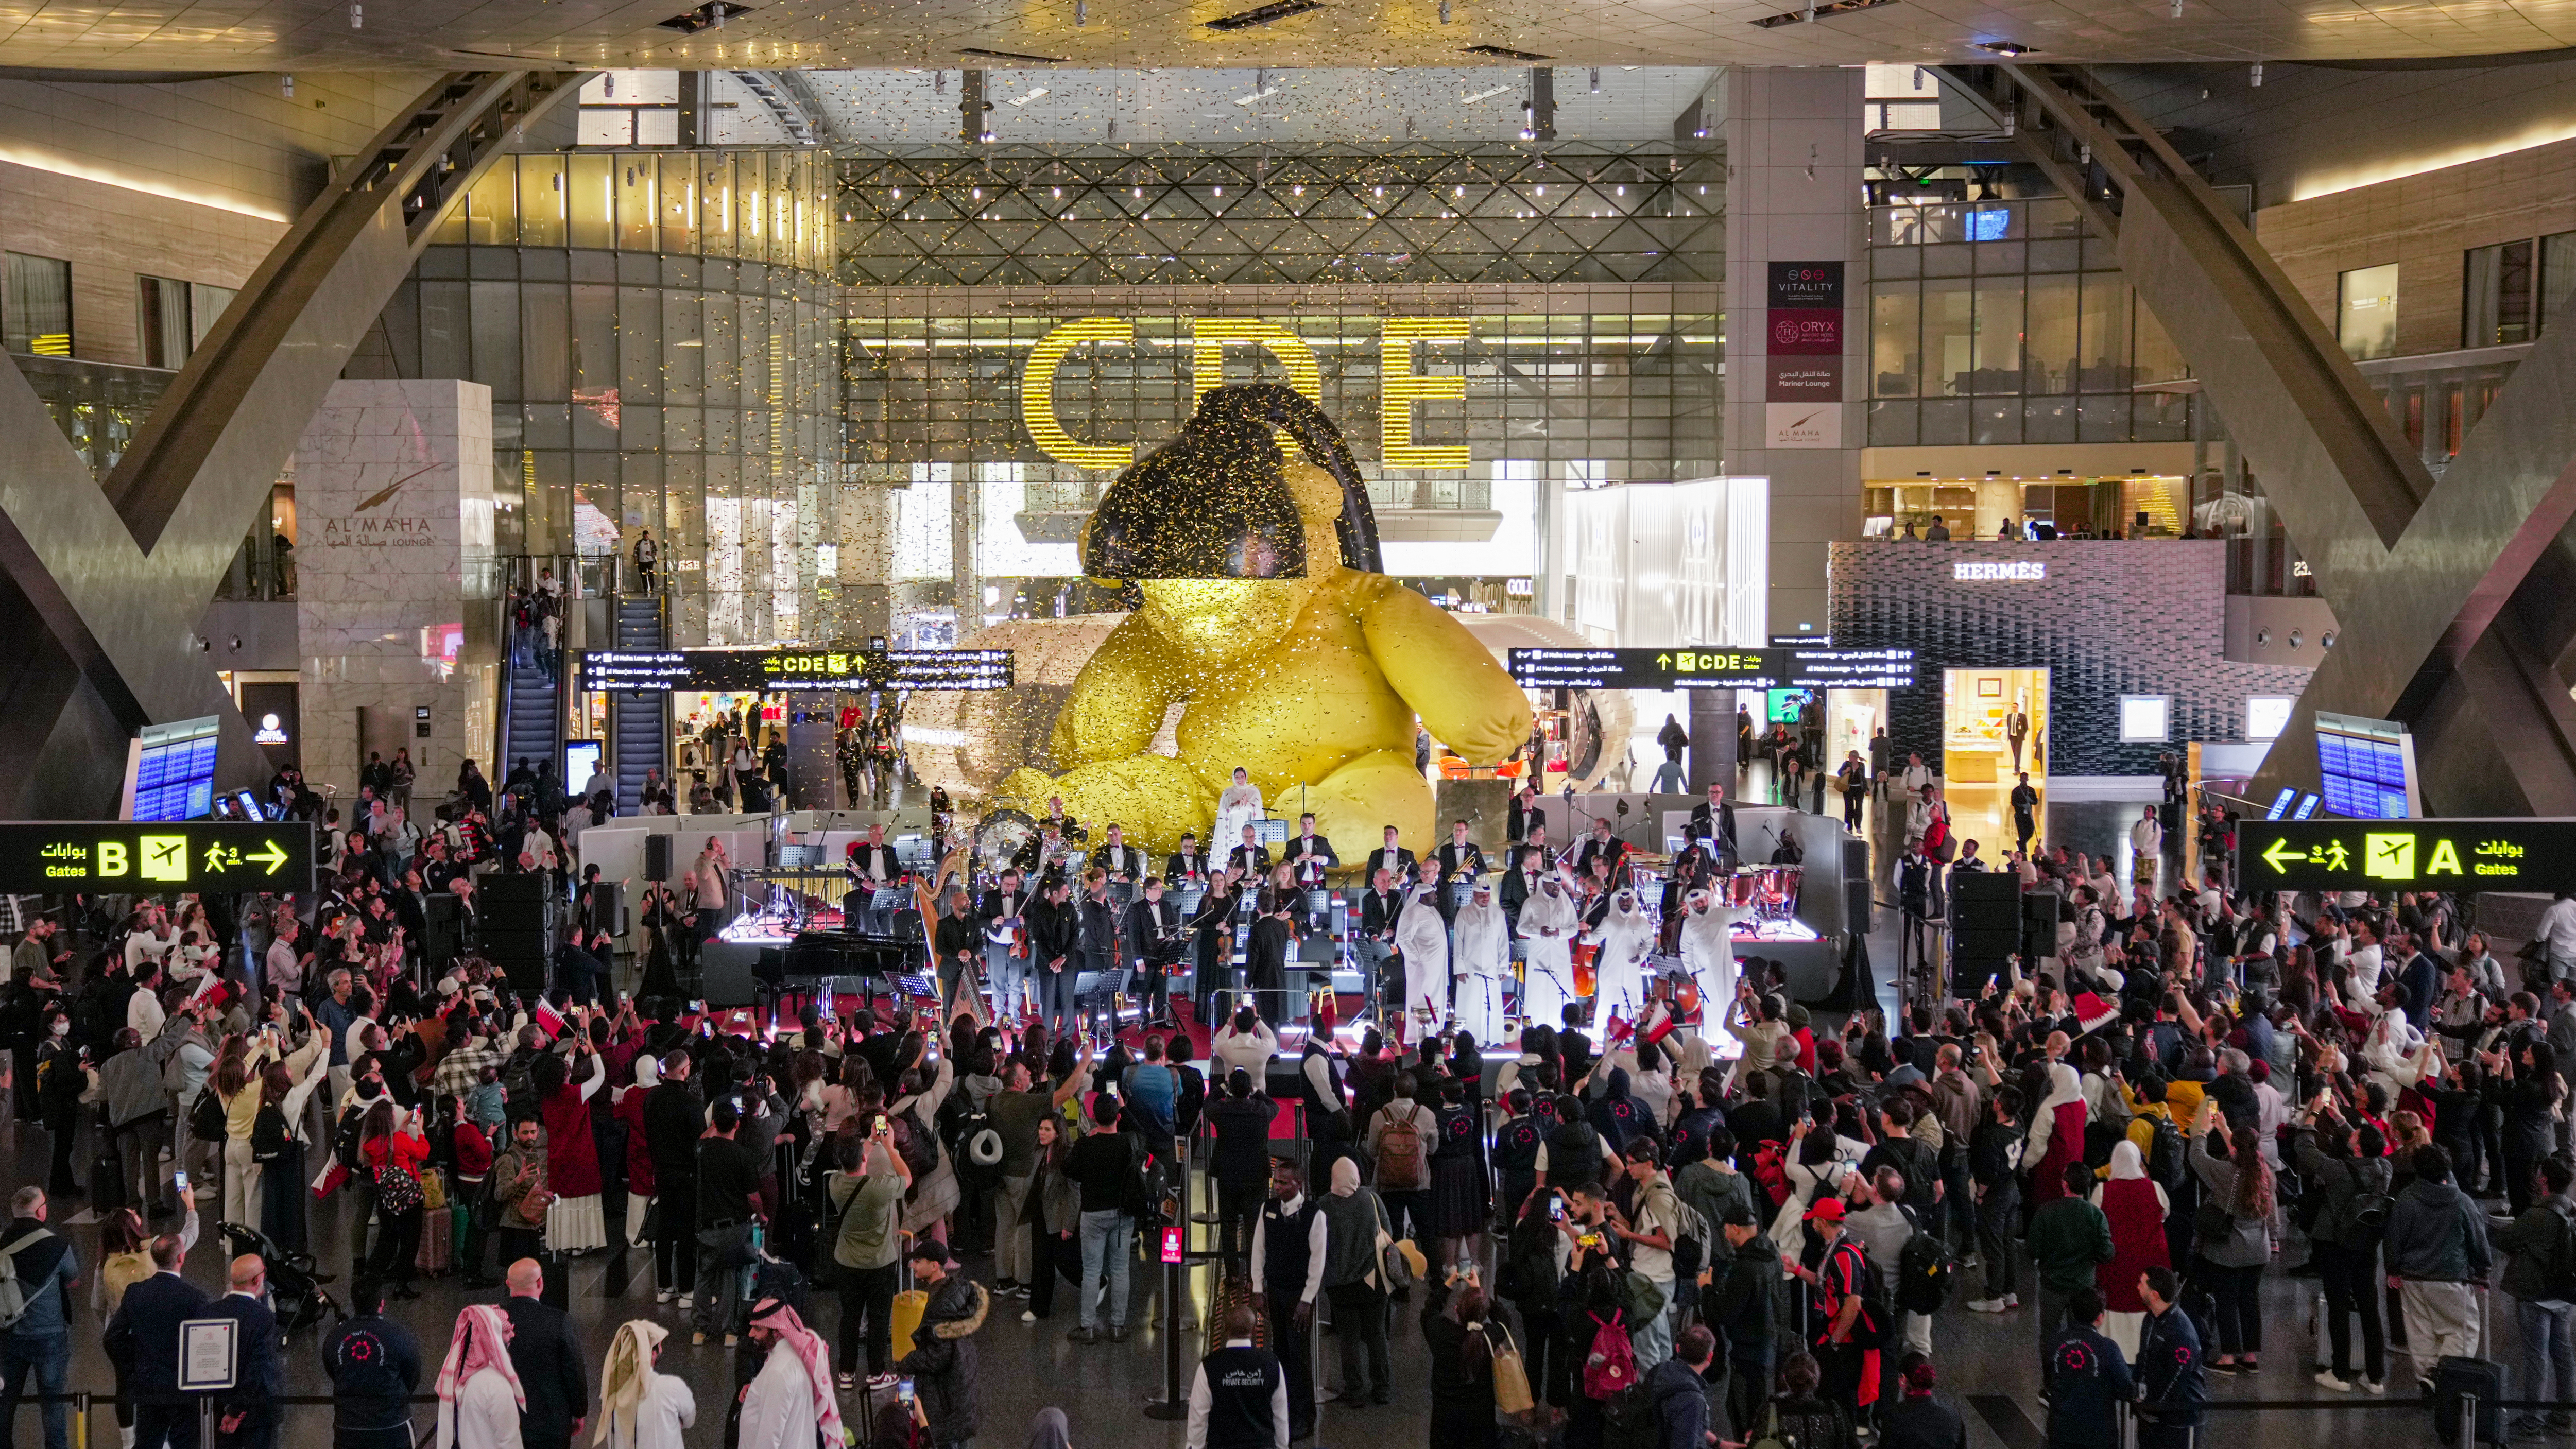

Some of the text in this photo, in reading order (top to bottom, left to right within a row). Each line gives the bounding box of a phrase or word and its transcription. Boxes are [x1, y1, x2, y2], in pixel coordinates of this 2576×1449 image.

[1801, 322, 1834, 332] ORYX
[1779, 371, 1799, 380] البحري
[325, 518, 431, 532] AL MAHA
[356, 534, 387, 547] صالة
[783, 657, 824, 672] CDE
[1699, 655, 1740, 669] CDE
[41, 842, 87, 860] بوابات
[229, 848, 237, 857] 3
[2312, 846, 2322, 856] 3
[2474, 840, 2523, 858] بوابات
[98, 842, 128, 877] B
[2426, 839, 2463, 875] A
[46, 866, 87, 877] Gates
[2474, 864, 2518, 875] Gates
[1225, 1368, 1262, 1379] أمن خاص
[1241, 1377, 1265, 1386] SECURITY
